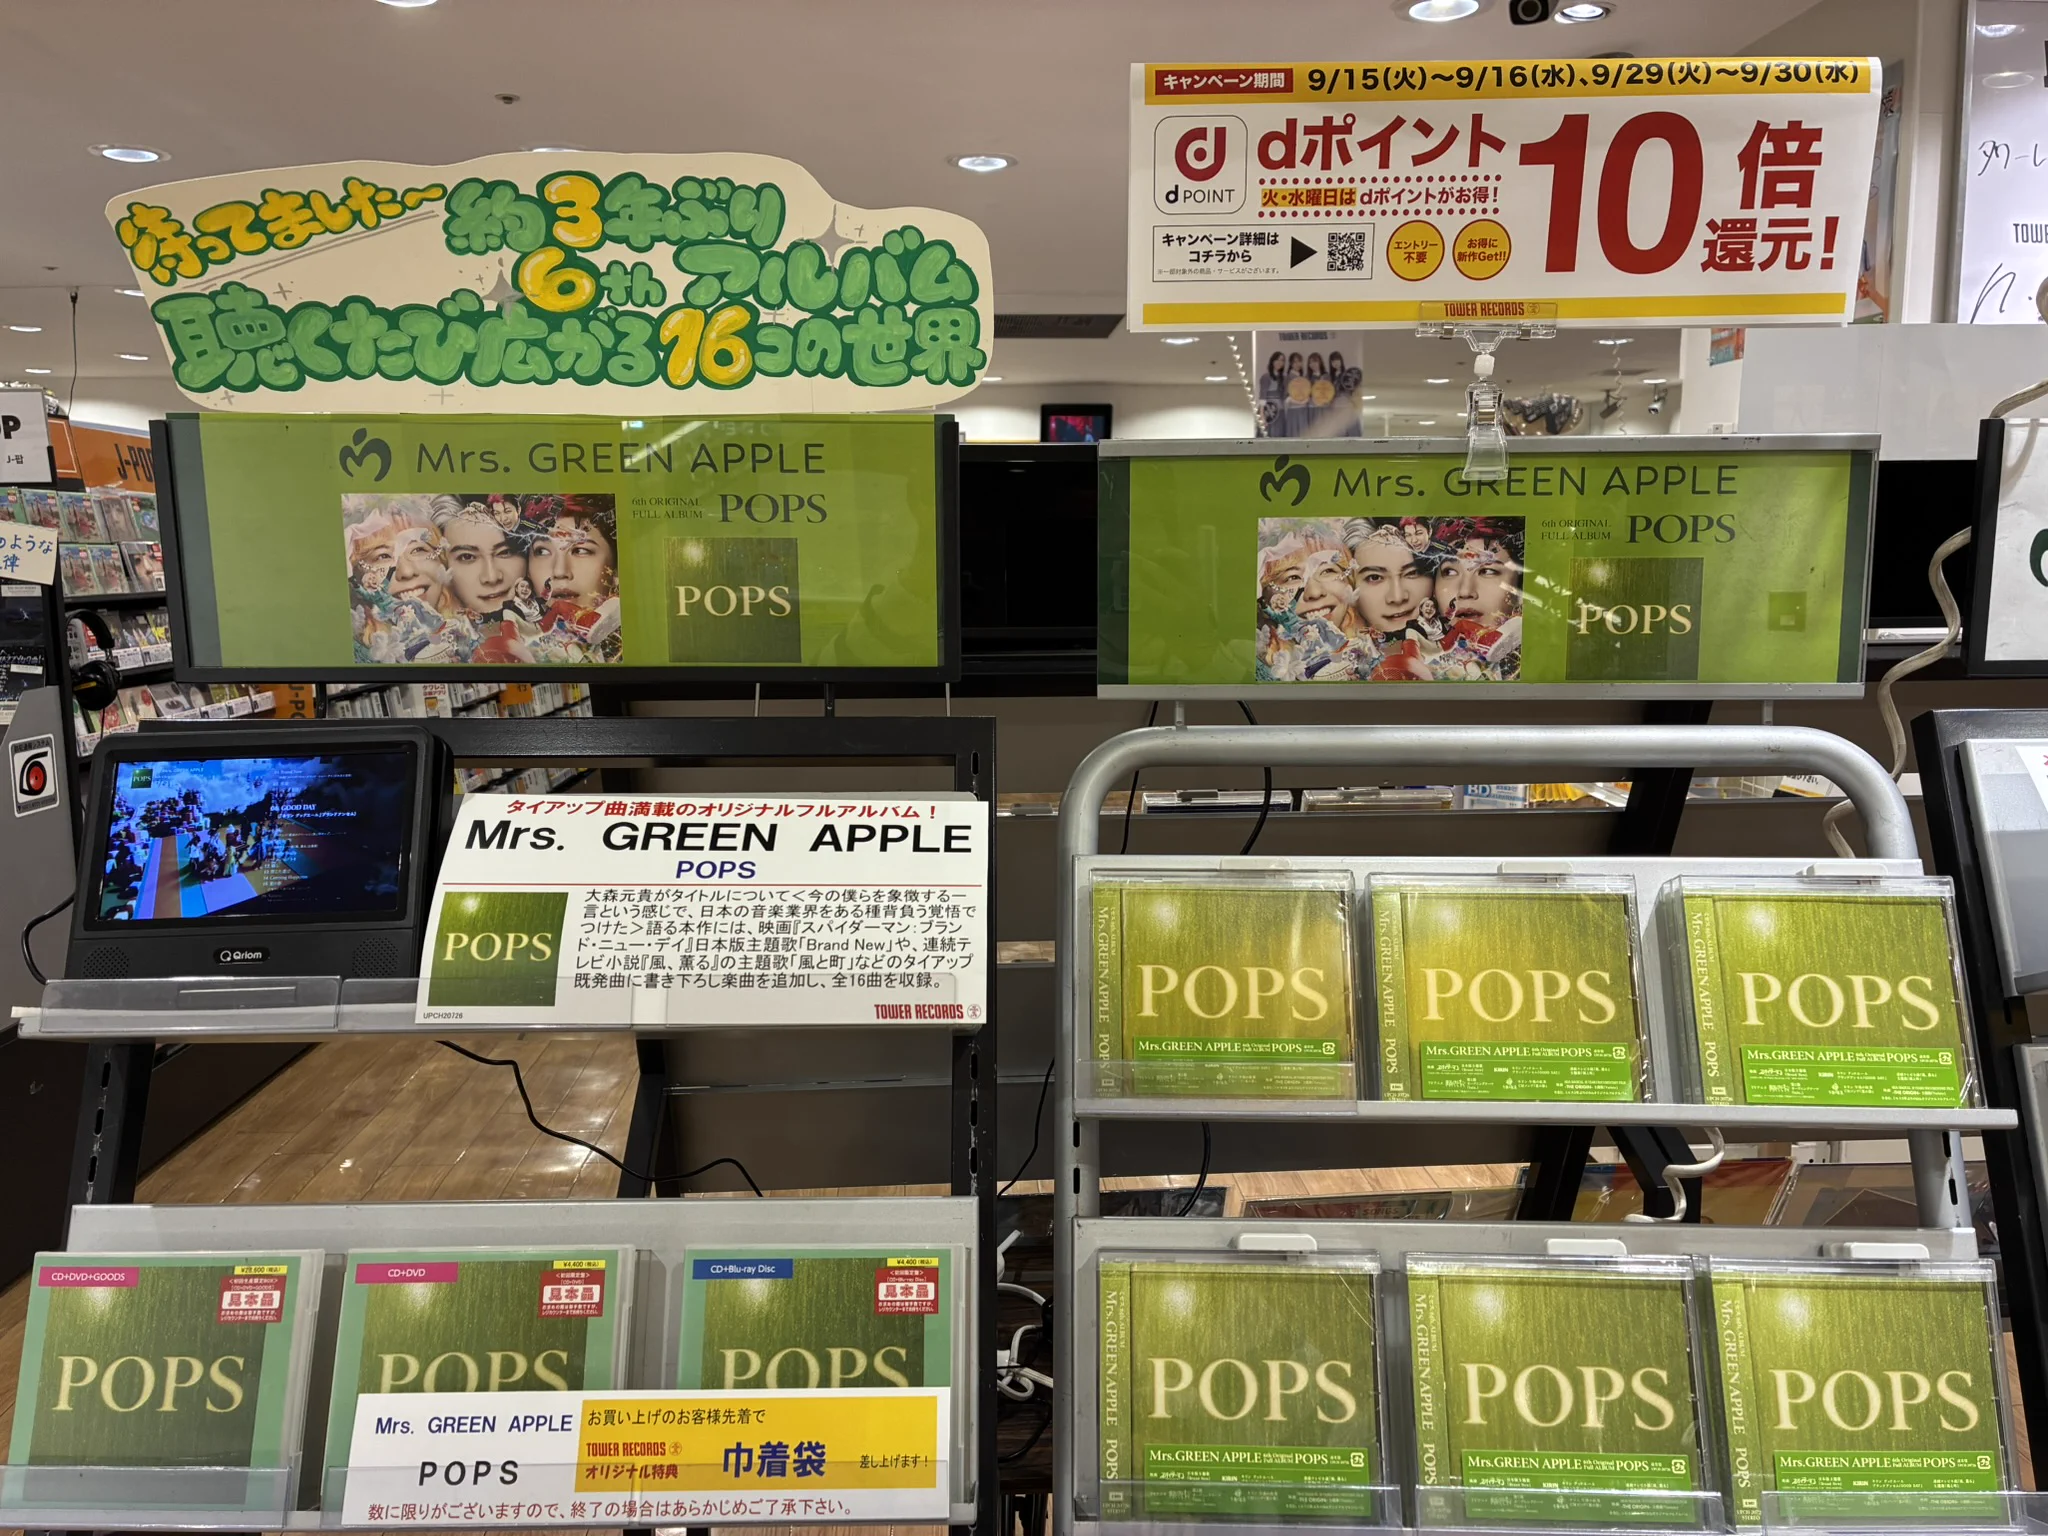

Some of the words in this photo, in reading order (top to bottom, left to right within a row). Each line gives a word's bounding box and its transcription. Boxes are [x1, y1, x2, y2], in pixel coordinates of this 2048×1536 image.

[1162, 72, 1285, 91] キャンペーン期間
[1258, 113, 1506, 172] dポイント
[1737, 120, 1823, 211] 倍
[1183, 188, 1236, 204] POINT
[1519, 111, 1704, 276] 10
[443, 170, 786, 253] 約3年ぶり
[1162, 232, 1280, 247] キャンペーン詳細は
[1394, 241, 1438, 250] エントリー
[1467, 239, 1498, 249] お得に
[1700, 215, 1836, 275] 還元!
[1189, 250, 1252, 263] コチラから
[1403, 252, 1428, 264] 不要
[1457, 251, 1507, 263] 新作Get!!
[1444, 303, 1478, 317] TOWER
[1481, 302, 1525, 316] RECORDS
[416, 443, 511, 474] Mrs.
[528, 442, 673, 474] GREEN
[690, 443, 826, 474] APPLE
[1333, 467, 1426, 498] Mrs.
[1443, 466, 1586, 497] GREEN
[1602, 465, 1739, 496] APPLE
[632, 497, 647, 507] 6th
[649, 497, 701, 507] ORIGINAL
[720, 493, 828, 524] POPS
[632, 509, 661, 520] FULL
[663, 509, 703, 520] ALBUM
[1541, 518, 1556, 529] 6th
[1558, 518, 1612, 529] ORIGINAL
[1626, 514, 1737, 544] POPS
[1541, 531, 1569, 541] FULL
[1571, 531, 1612, 541] ALBUM
[676, 585, 792, 617] POPS
[1577, 604, 1692, 636] POPS
[464, 819, 566, 852] Mrs.
[602, 822, 778, 852] GREEN
[809, 824, 972, 853] APPLE
[676, 860, 757, 880] POPS
[583, 904, 977, 919] 言という感じで、日本の音楽業界をある種背負う覚悟で
[443, 932, 553, 963] POPS
[574, 972, 941, 989] 既発曲に書き下ろし楽曲を追加し、全16曲を収録。
[1136, 965, 1329, 1021] POPS
[1420, 968, 1616, 1024] POPS
[1736, 972, 1940, 1031] POPS
[873, 1004, 911, 1020] TOWER
[914, 1004, 964, 1020] RECORDS
[1099, 1033, 1110, 1069] POPS
[1205, 1042, 1242, 1053] APPLE
[1271, 1043, 1303, 1053] POPS
[1386, 1038, 1398, 1074] POPS
[1493, 1046, 1530, 1056] APPLE
[1560, 1047, 1592, 1057] POPS
[1704, 1041, 1719, 1077] POPS
[1817, 1051, 1855, 1062] APPLE
[1886, 1052, 1918, 1063] POPS
[51, 1271, 126, 1283] CD+DVD+GOODS
[387, 1268, 426, 1278] CD+DVD
[710, 1264, 754, 1275] CD+Blu-ray
[755, 1264, 776, 1273] Disc
[228, 1292, 274, 1307] 見本品
[549, 1286, 595, 1301] 見本品
[884, 1283, 929, 1299] 見本品
[378, 1349, 570, 1392] POPS
[720, 1346, 909, 1388] POPS
[51, 1355, 246, 1414] POPS
[1147, 1357, 1357, 1424] POPS
[1459, 1363, 1675, 1431] POPS
[1768, 1368, 1979, 1432] POPS
[375, 1417, 414, 1434] Mrs.
[428, 1416, 497, 1434] GREEN
[508, 1414, 573, 1432] APPLE
[588, 1408, 766, 1426] お買い上げのお客様先着で
[585, 1442, 620, 1457] TOWER
[622, 1441, 666, 1457] RECORDS
[722, 1441, 827, 1478] 巾着袋
[1106, 1438, 1119, 1480] POPS
[1222, 1452, 1263, 1464] APPLE
[1295, 1453, 1329, 1465] POPS
[1423, 1443, 1438, 1484] POPS
[1542, 1458, 1583, 1470] APPLE
[1615, 1460, 1650, 1472] POPS
[1851, 1457, 1891, 1468] APPLE
[1922, 1457, 1956, 1468] POPS
[585, 1464, 679, 1480] オリジナル特典
[1735, 1447, 1751, 1488] POPS
[368, 1498, 853, 1521] 数に限りがございますので、終了の場合はあらかじめご了承下さい。
